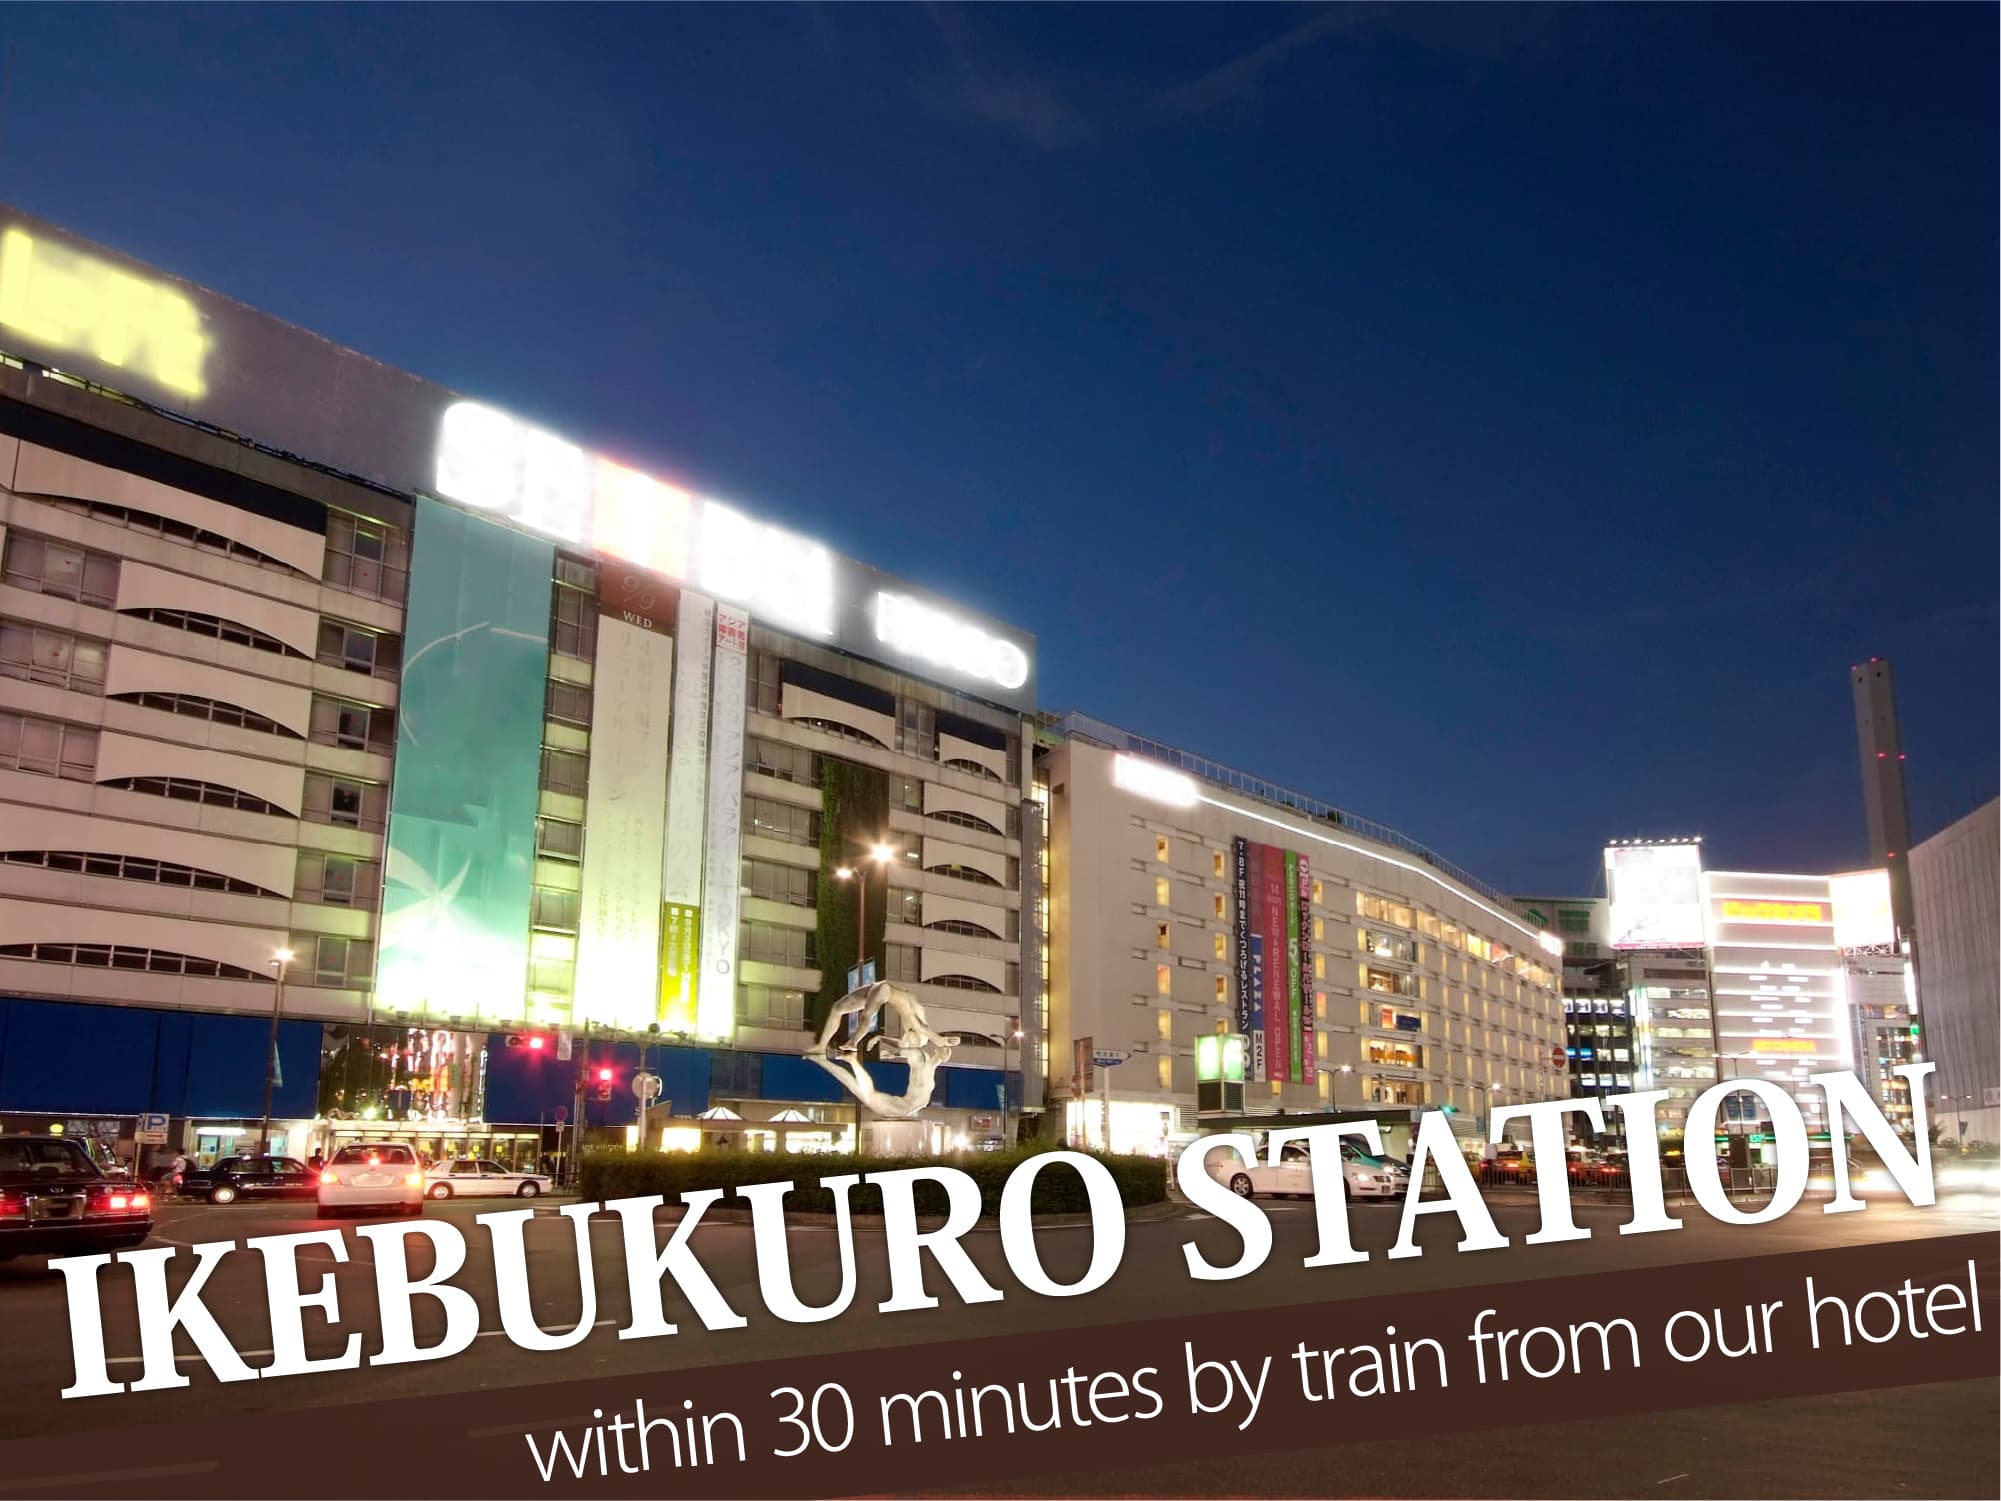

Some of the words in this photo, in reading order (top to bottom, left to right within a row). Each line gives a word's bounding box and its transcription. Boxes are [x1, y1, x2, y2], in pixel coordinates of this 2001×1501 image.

[622, 611, 653, 629] WED
[1255, 1033, 1263, 1071] M2F
[147, 1115, 166, 1130] P
